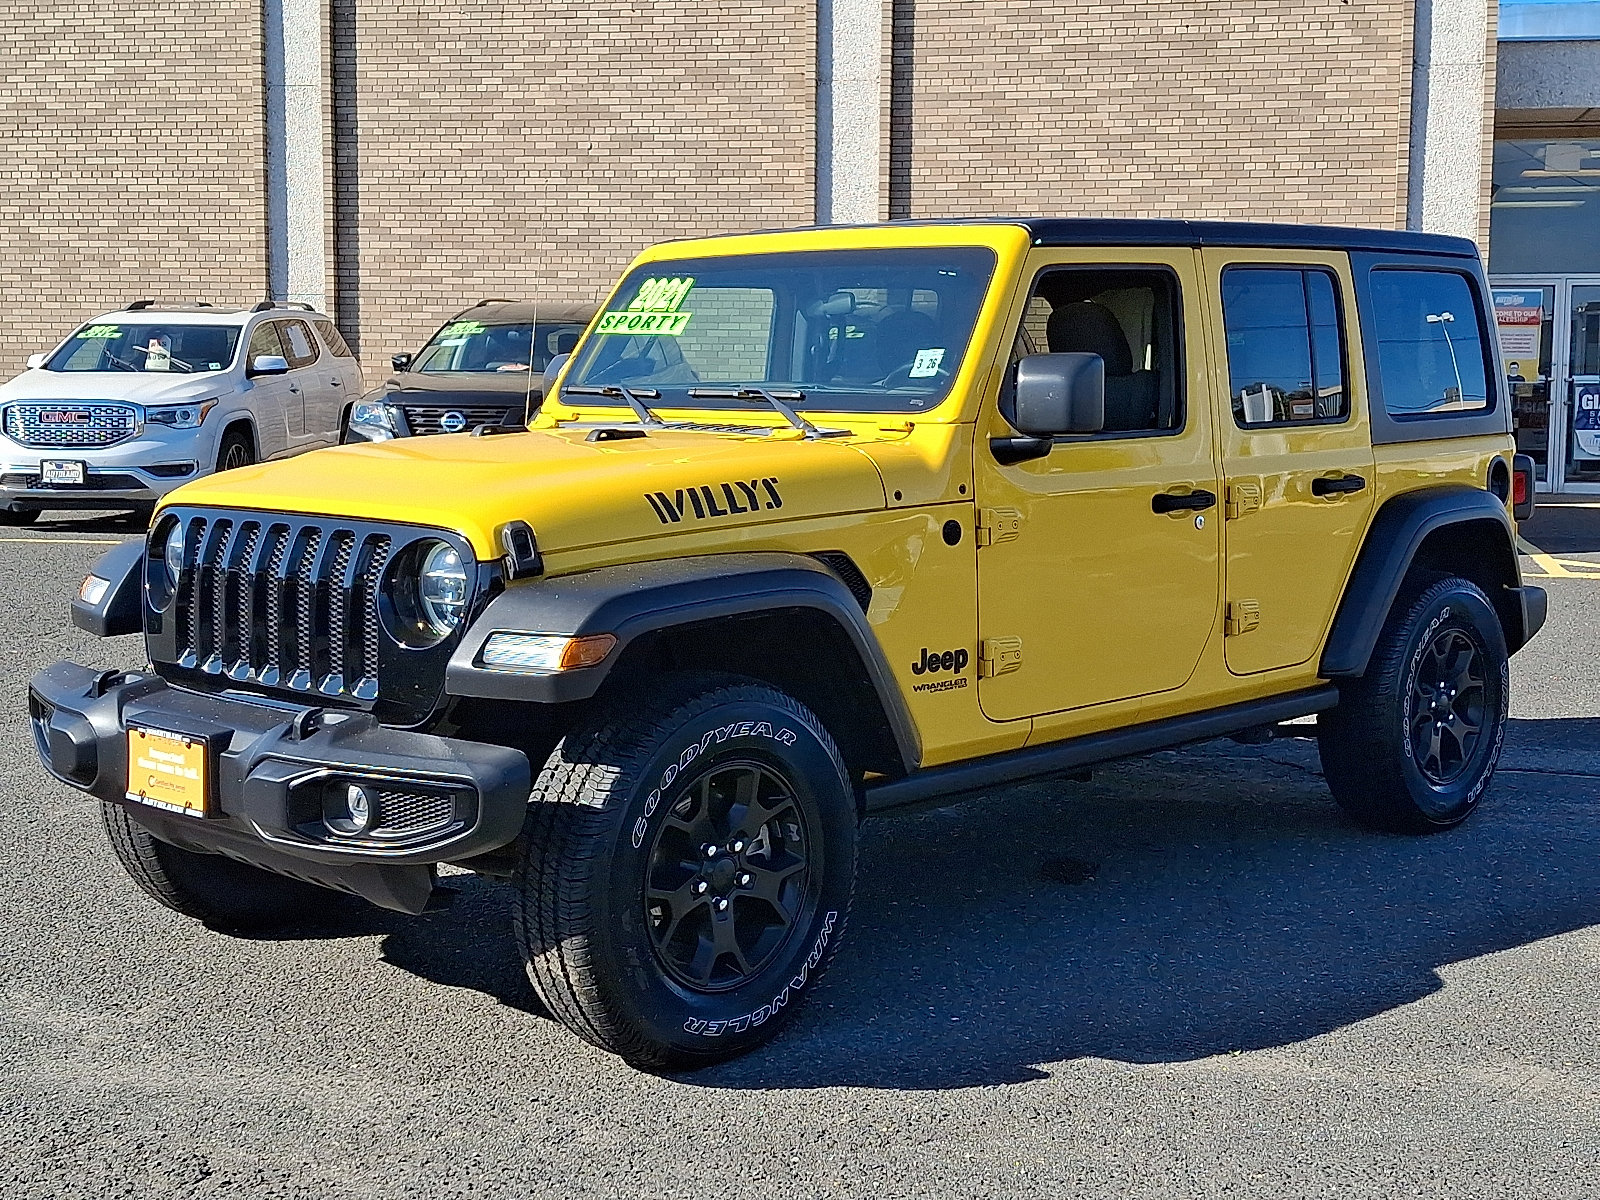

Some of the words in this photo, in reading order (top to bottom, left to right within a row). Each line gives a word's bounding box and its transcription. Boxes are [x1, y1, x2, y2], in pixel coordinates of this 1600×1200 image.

[628, 277, 695, 312] 2021
[600, 315, 687, 331] SPORTY
[916, 359, 924, 369] 3
[926, 358, 938, 369] 26
[42, 411, 91, 423] GMC
[643, 477, 782, 524] WILLYS
[911, 647, 969, 675] Jeep
[912, 677, 968, 692] WRANGLER
[631, 721, 797, 849] GOODYEAR
[684, 911, 838, 1036] WRANGLER
